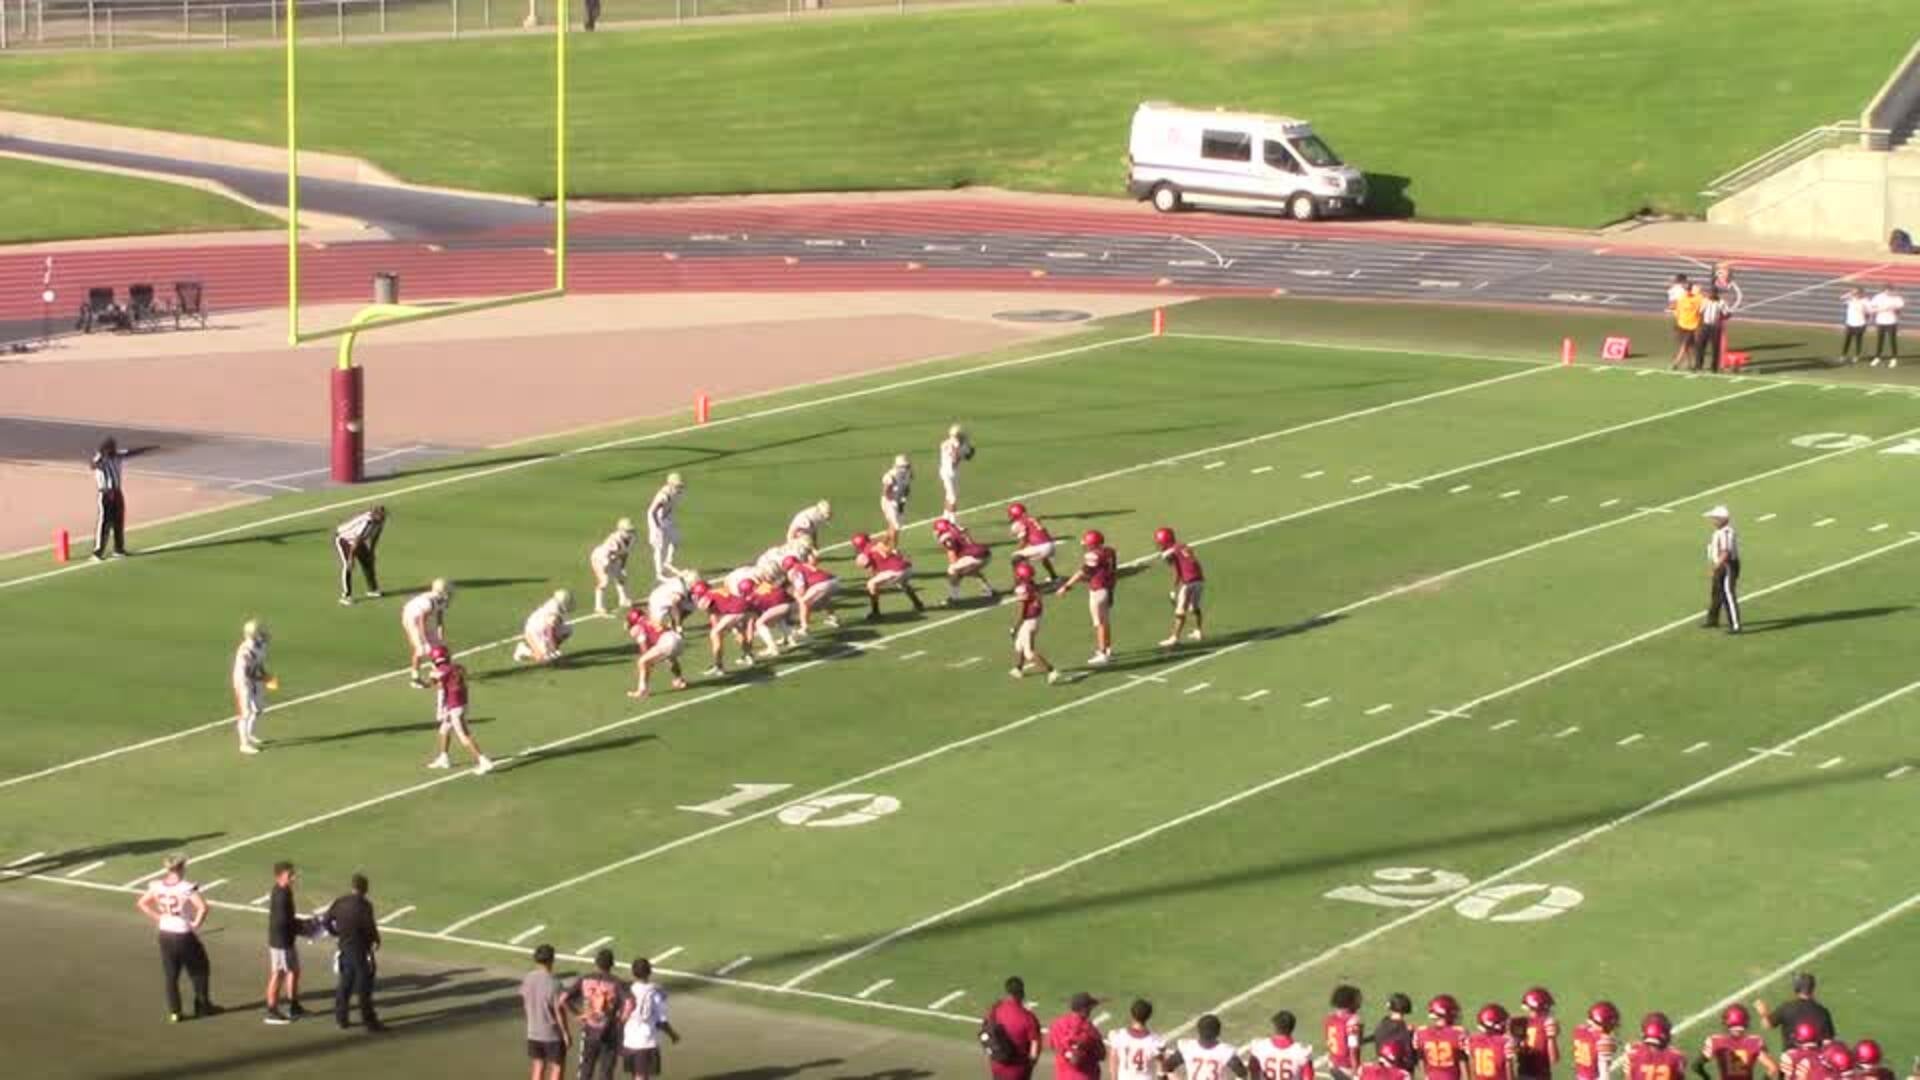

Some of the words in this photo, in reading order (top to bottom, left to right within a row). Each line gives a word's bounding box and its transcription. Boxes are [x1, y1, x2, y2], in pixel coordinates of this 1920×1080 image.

[677, 783, 901, 826] 10
[1323, 867, 1584, 922] 20
[1124, 1048, 1145, 1070] 14
[1193, 1057, 1220, 1080] 73
[1265, 1057, 1294, 1080] 66
[1474, 1047, 1496, 1079] 16
